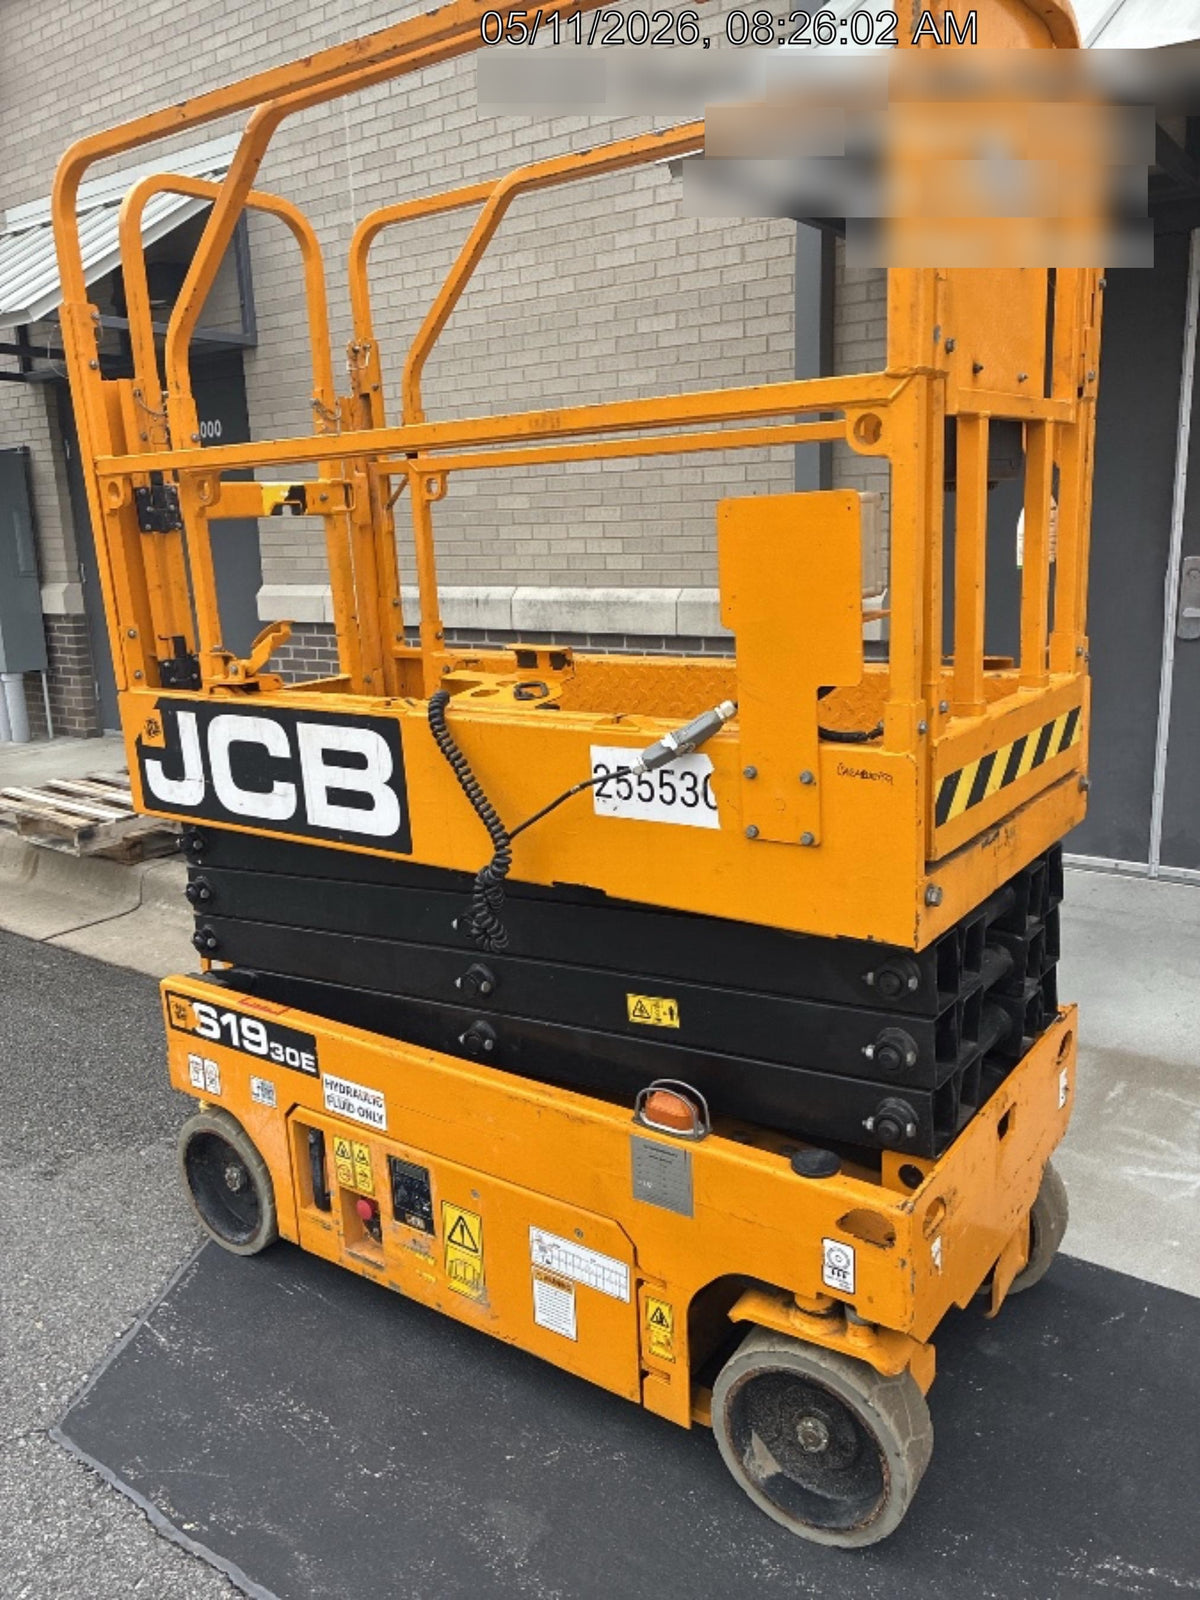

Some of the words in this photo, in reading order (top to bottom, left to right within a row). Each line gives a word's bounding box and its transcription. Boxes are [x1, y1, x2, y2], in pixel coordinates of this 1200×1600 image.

[144, 710, 401, 837] JCB
[324, 1078, 384, 1109] HYDRAULIC
[326, 1093, 355, 1114] FLUID
[357, 1106, 384, 1125] ONLY
